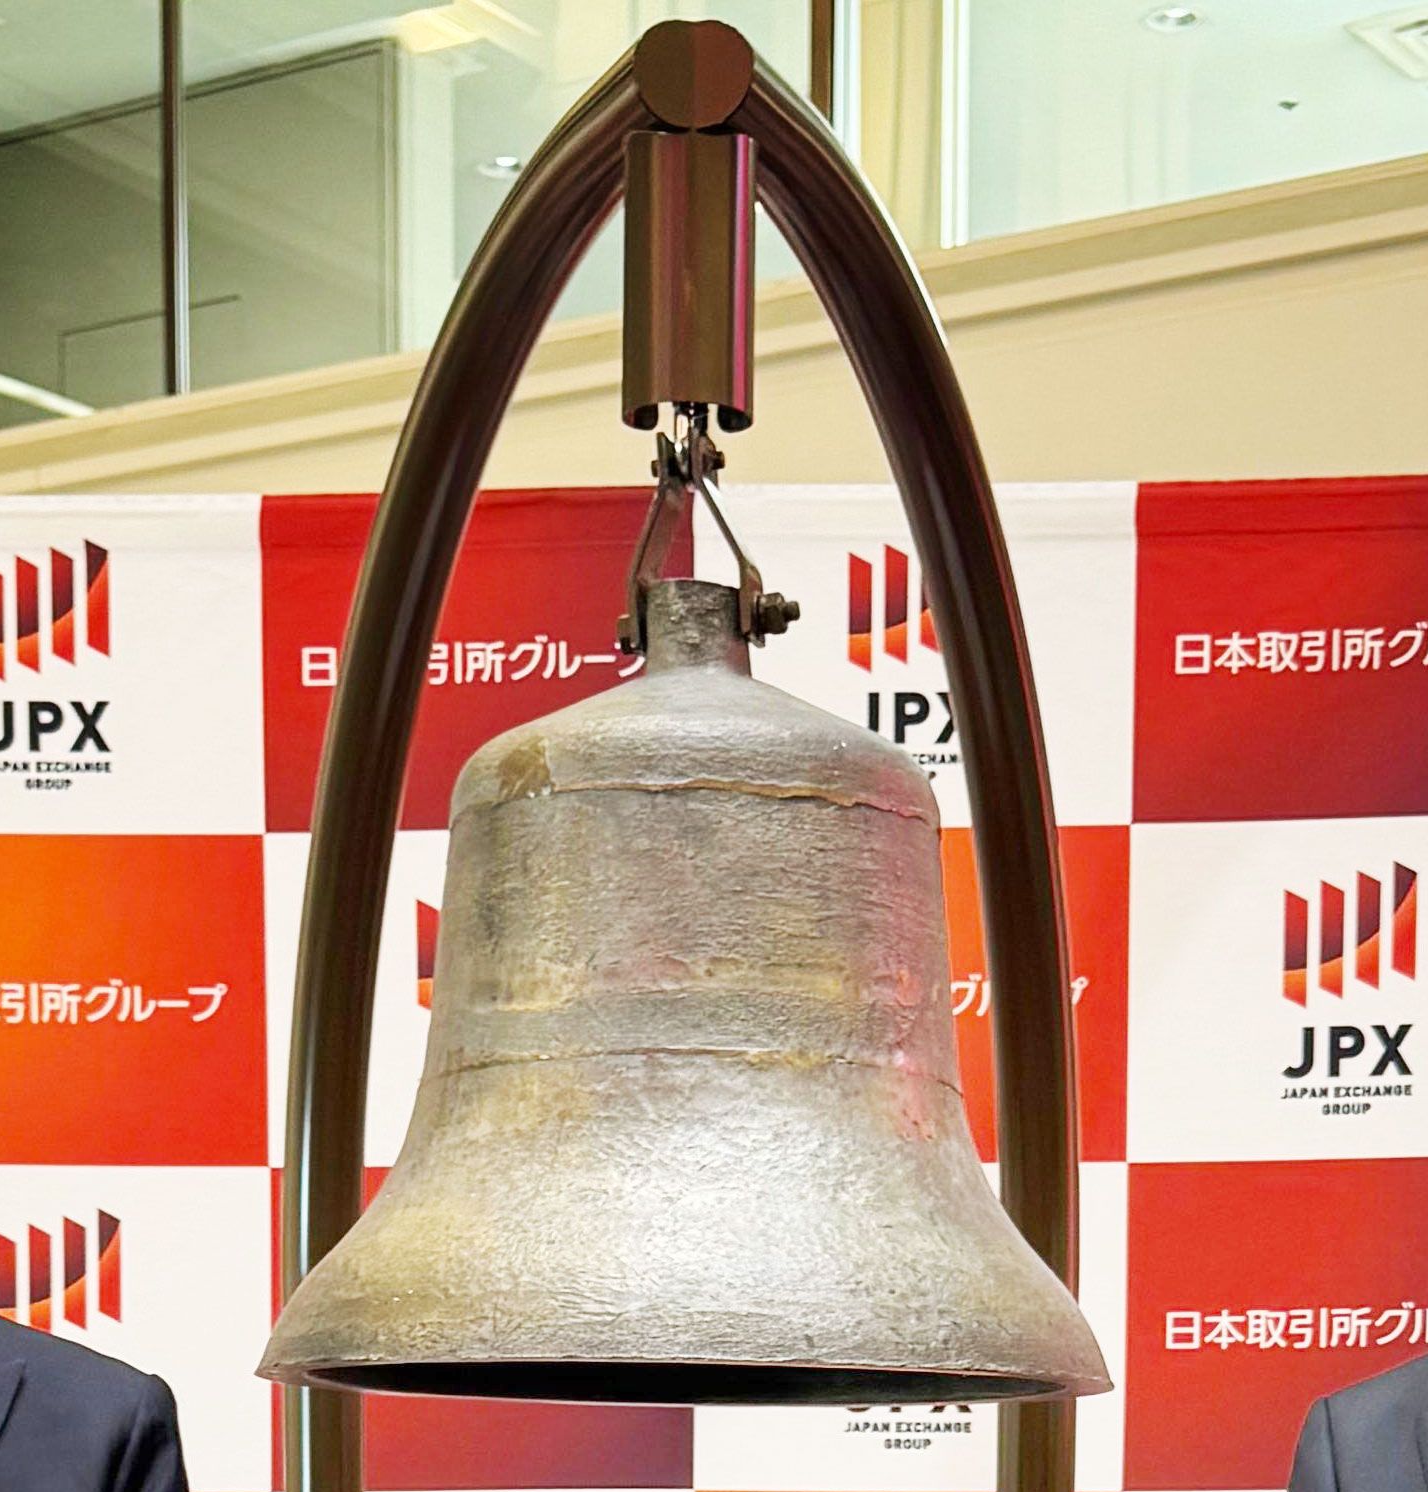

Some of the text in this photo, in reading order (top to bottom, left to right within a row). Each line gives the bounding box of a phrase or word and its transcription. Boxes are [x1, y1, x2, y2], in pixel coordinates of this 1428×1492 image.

[35, 760, 112, 774] EXCHANGE
[25, 778, 73, 791] GROUP
[1283, 1023, 1413, 1078] JPX
[1280, 1084, 1413, 1100] JAPAN EXCHANGE
[1322, 1102, 1372, 1116] GROUP
[844, 1421, 972, 1434] JAPAN EXCHANGE
[884, 1438, 932, 1450] GROUP
